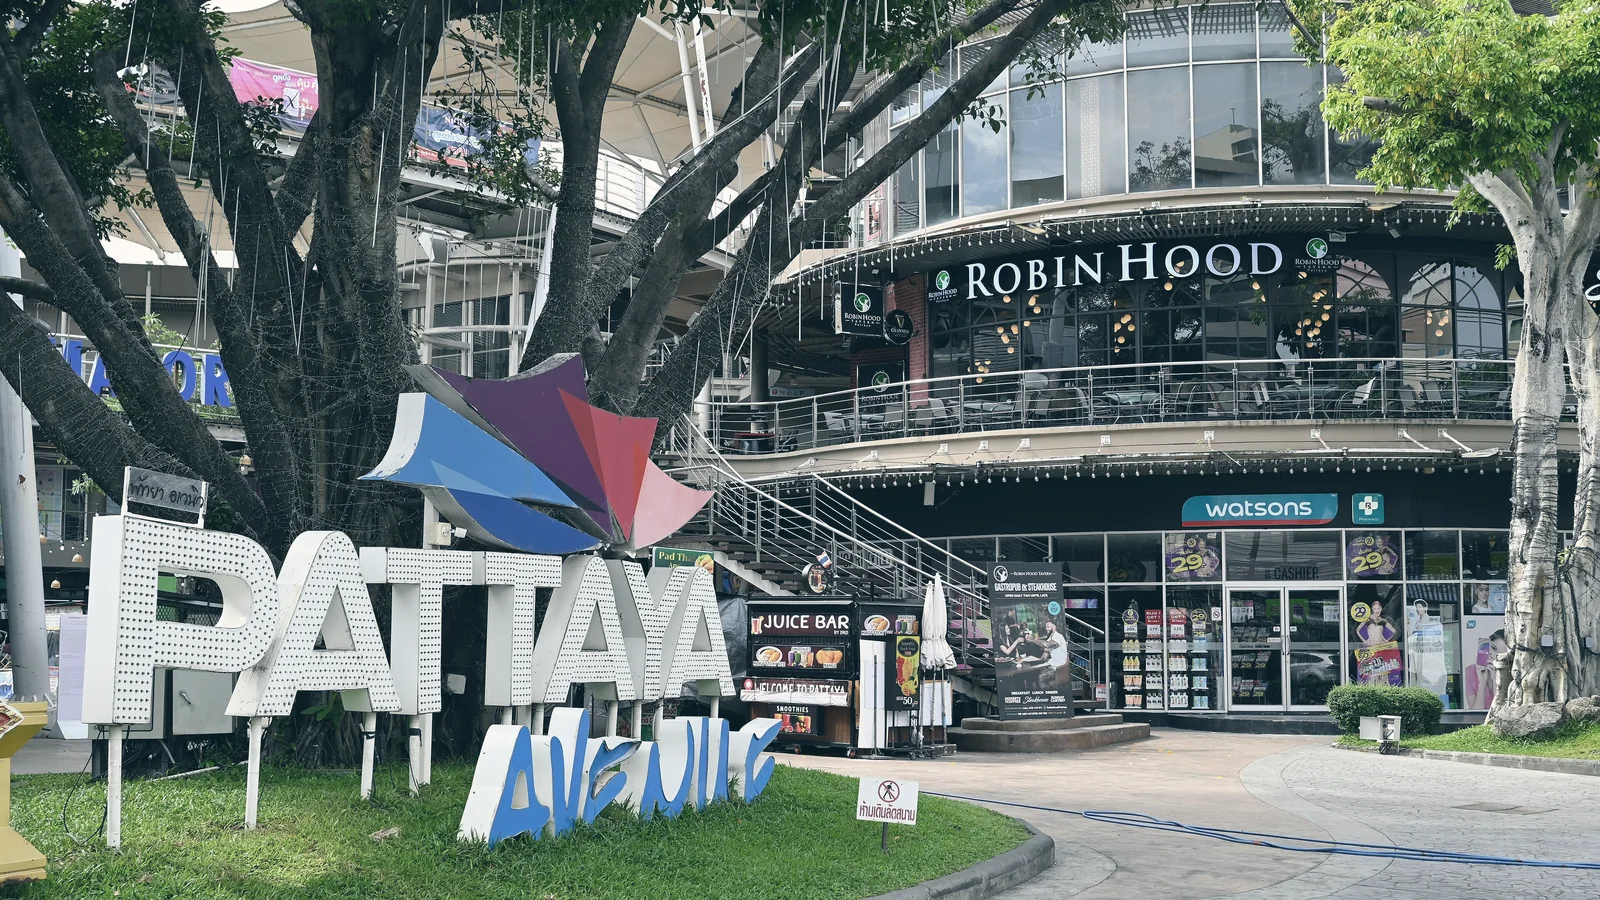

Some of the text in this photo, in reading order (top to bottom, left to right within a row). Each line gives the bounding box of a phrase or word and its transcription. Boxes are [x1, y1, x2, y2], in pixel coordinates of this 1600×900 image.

[965, 241, 1284, 300] ROBIN HOOD
[942, 288, 958, 297] HOOD
[844, 312, 862, 320] ROBIN
[1205, 500, 1312, 518] watsons
[659, 551, 675, 561] Pad
[1274, 566, 1319, 580] CASHIER
[994, 583, 1021, 592] GASTROPUB
[1028, 583, 1057, 592] STEAKHOUSE
[84, 503, 735, 725] PATTAYA
[1355, 606, 1367, 618] 29
[763, 614, 850, 629] JUICE BAR
[754, 682, 845, 694] WELCOME TO PATTAYA
[776, 704, 809, 713] SMOOTHIES
[458, 708, 779, 849] AVENUE
[859, 800, 917, 822] ห้ามเดินลัดสนาม
